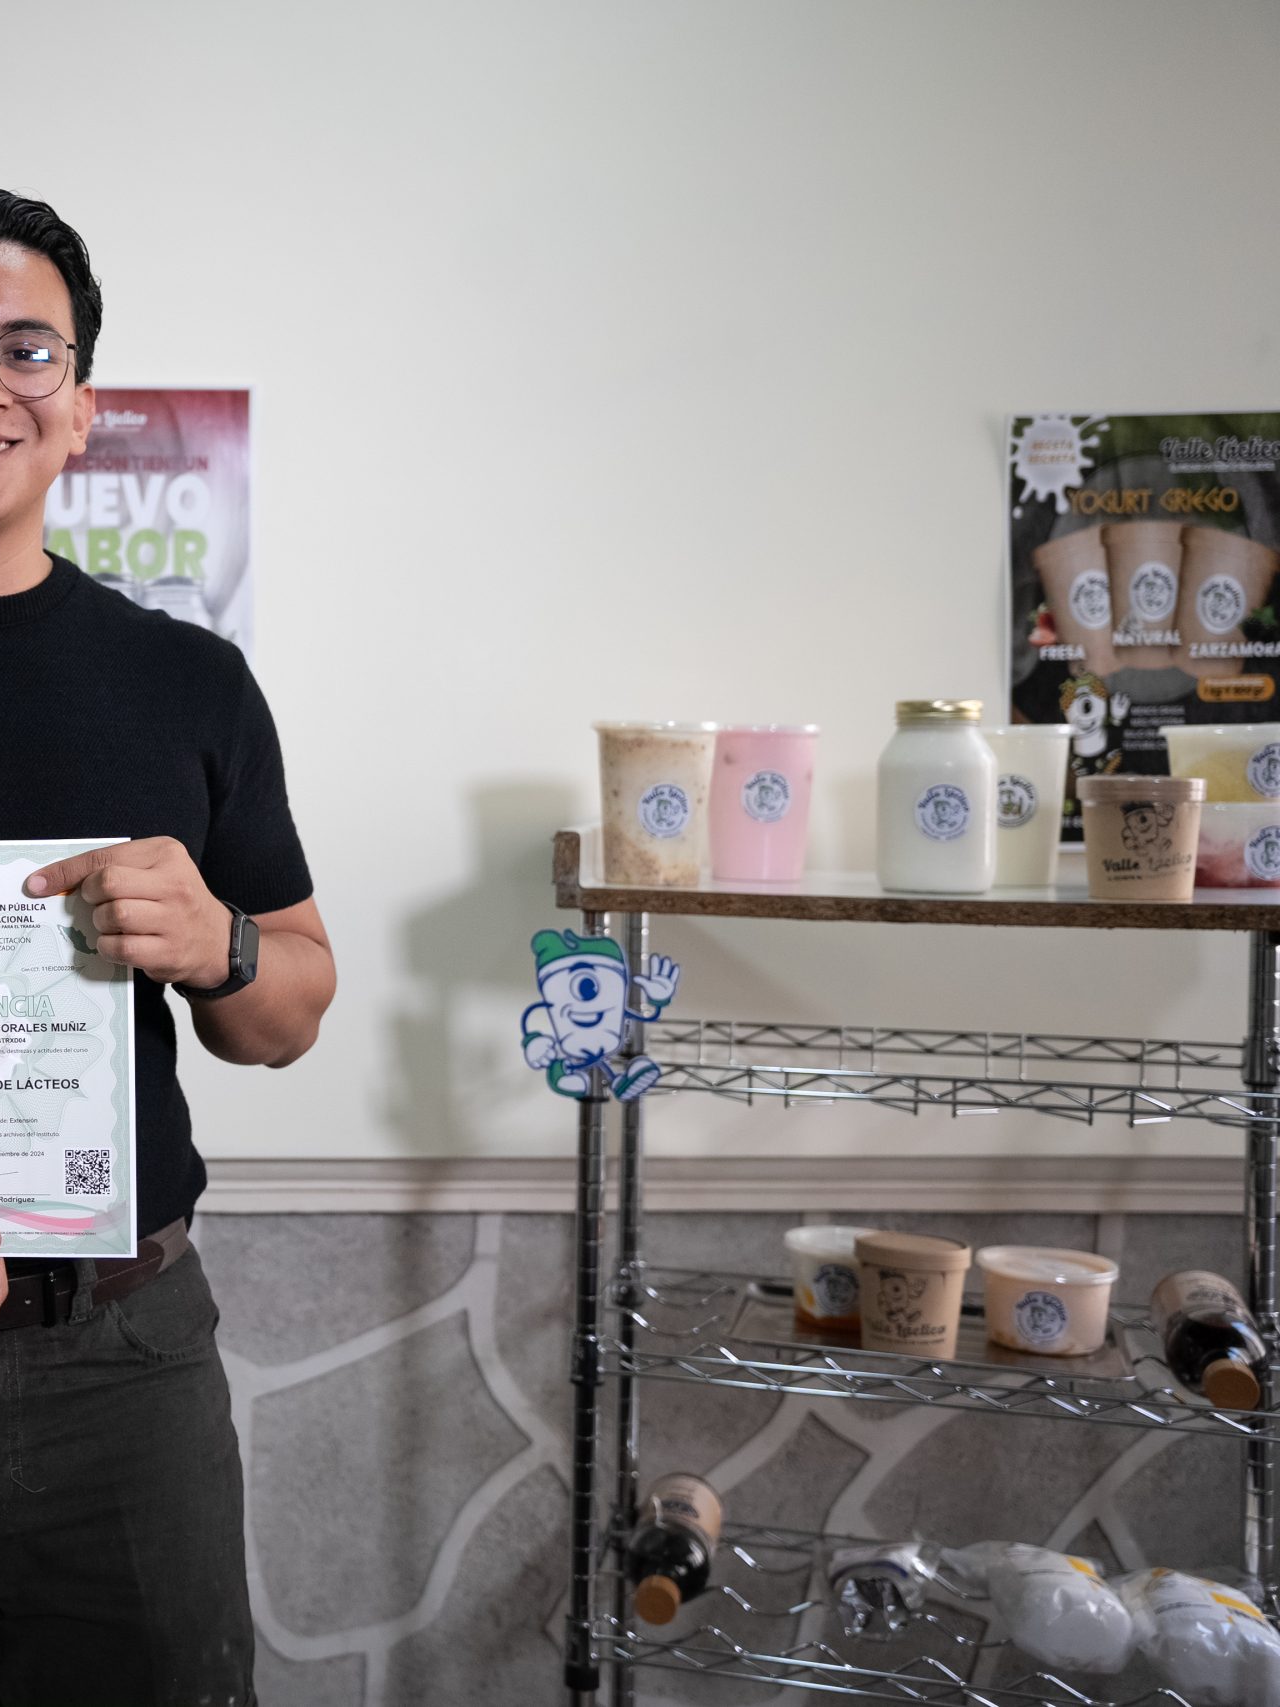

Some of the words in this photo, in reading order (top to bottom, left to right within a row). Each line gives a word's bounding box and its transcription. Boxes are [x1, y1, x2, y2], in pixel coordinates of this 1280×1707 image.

[184, 455, 209, 471] UN
[45, 473, 210, 527] UEVO
[1070, 488, 1151, 513] YOGURT
[1160, 488, 1238, 512] GRIEGO
[46, 527, 208, 580] ABOR
[1112, 629, 1182, 646] NATURAL
[1039, 645, 1086, 661] FRESA
[1103, 858, 1140, 872] Valle
[8, 902, 46, 911] PÚBLICA
[51, 1020, 87, 1032] MUÑIZ
[16, 1077, 80, 1090] LÁCTEOS
